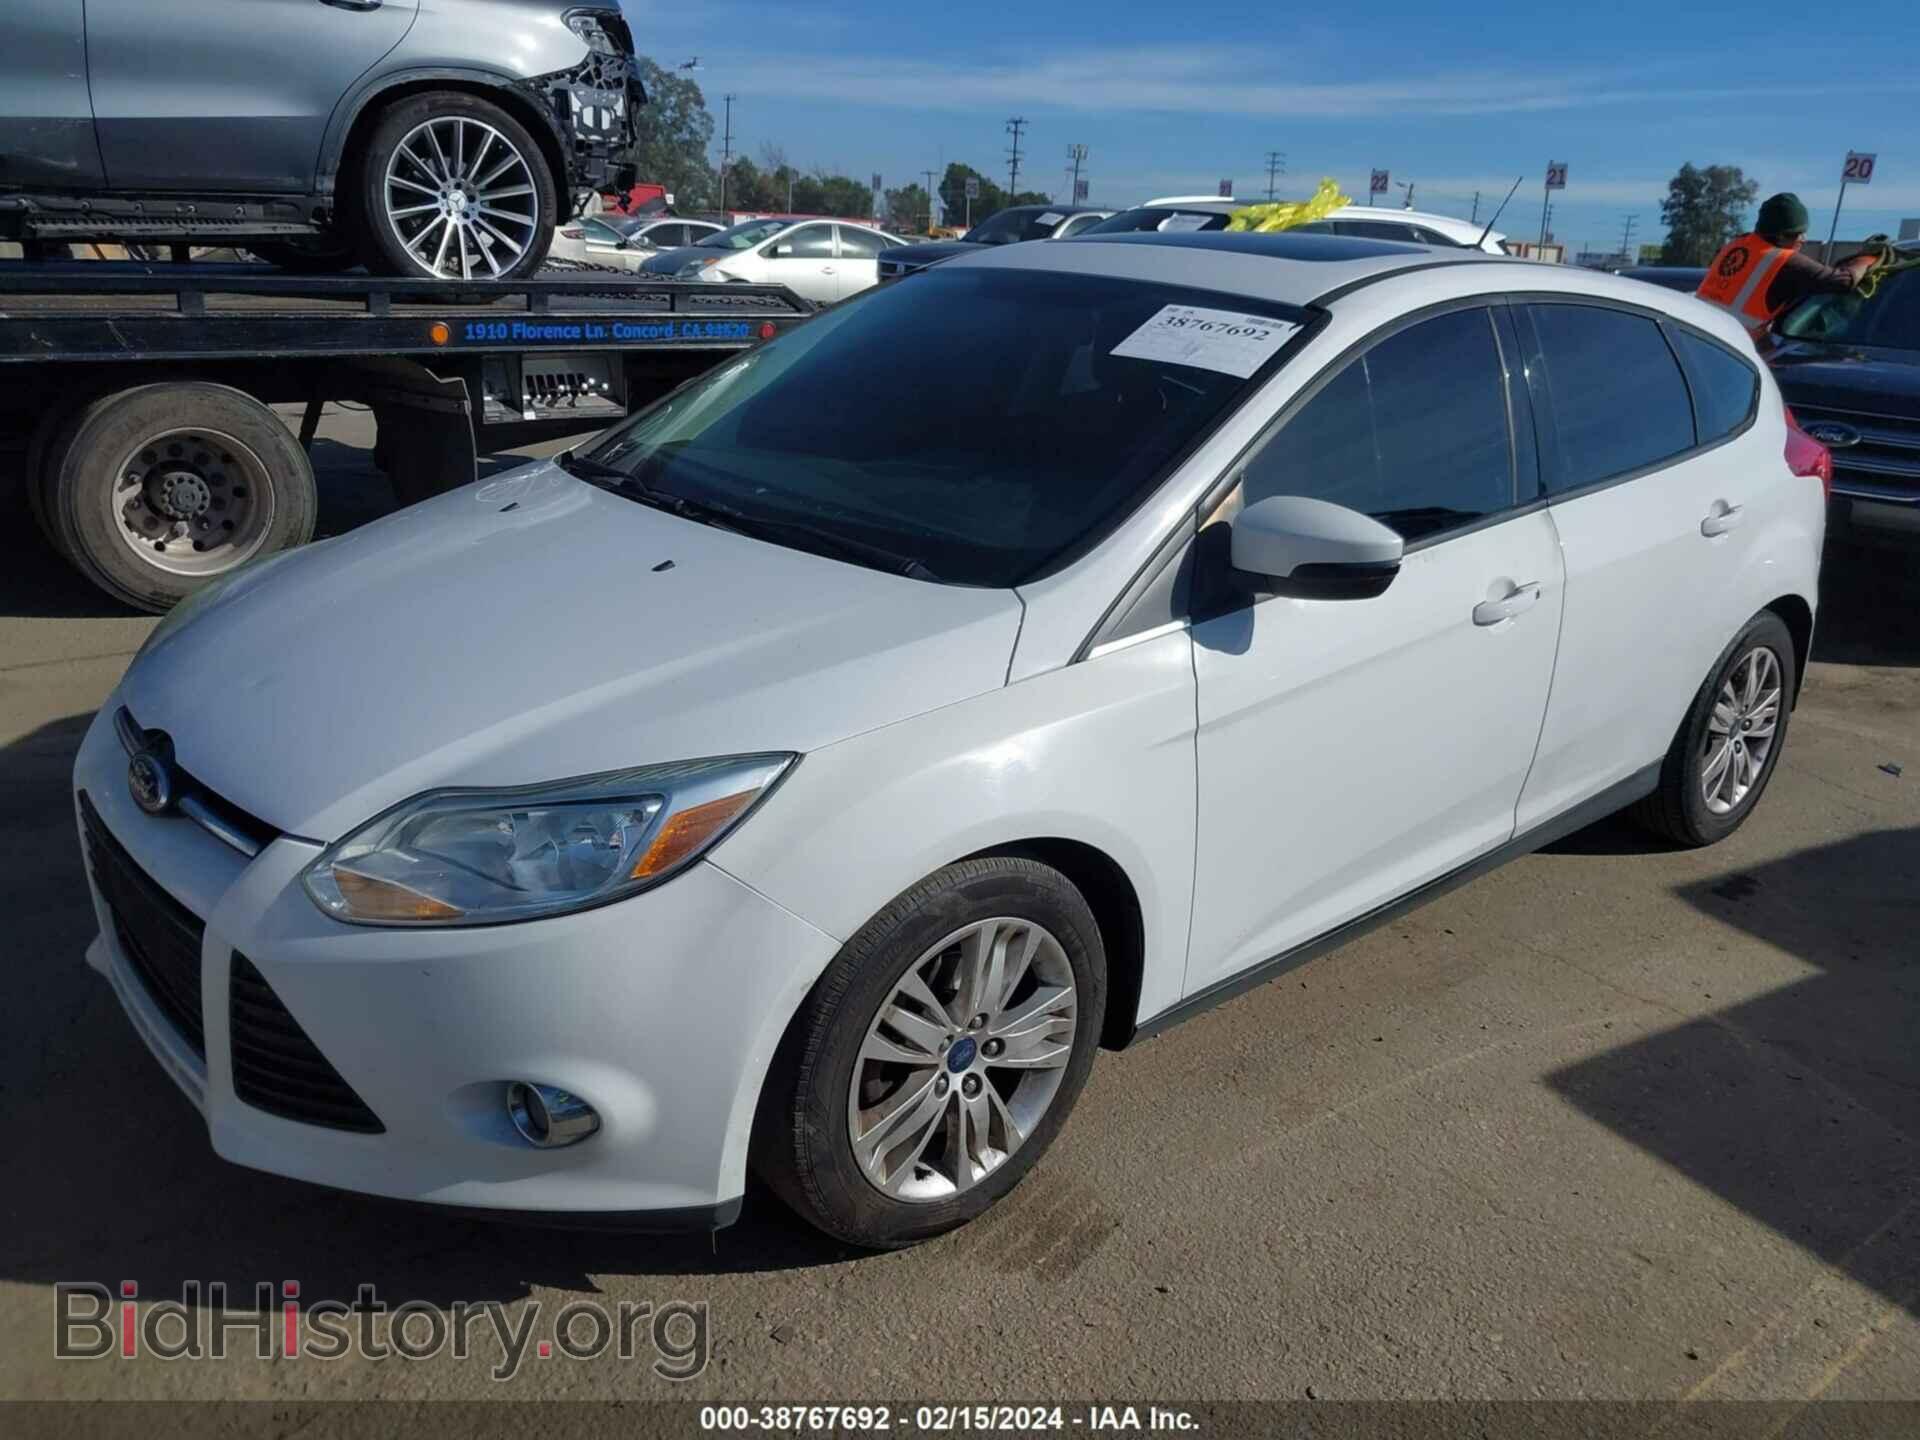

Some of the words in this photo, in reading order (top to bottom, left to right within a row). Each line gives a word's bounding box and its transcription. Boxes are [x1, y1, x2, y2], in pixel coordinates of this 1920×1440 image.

[1546, 168, 1565, 185] 21
[1844, 158, 1872, 178] 20
[1370, 173, 1388, 191] 22
[465, 323, 507, 339] 1910
[511, 323, 581, 339] Florence
[584, 323, 608, 339] Ln.
[611, 321, 674, 338] Concord
[682, 323, 701, 337] CA
[1158, 315, 1271, 341] 38767692
